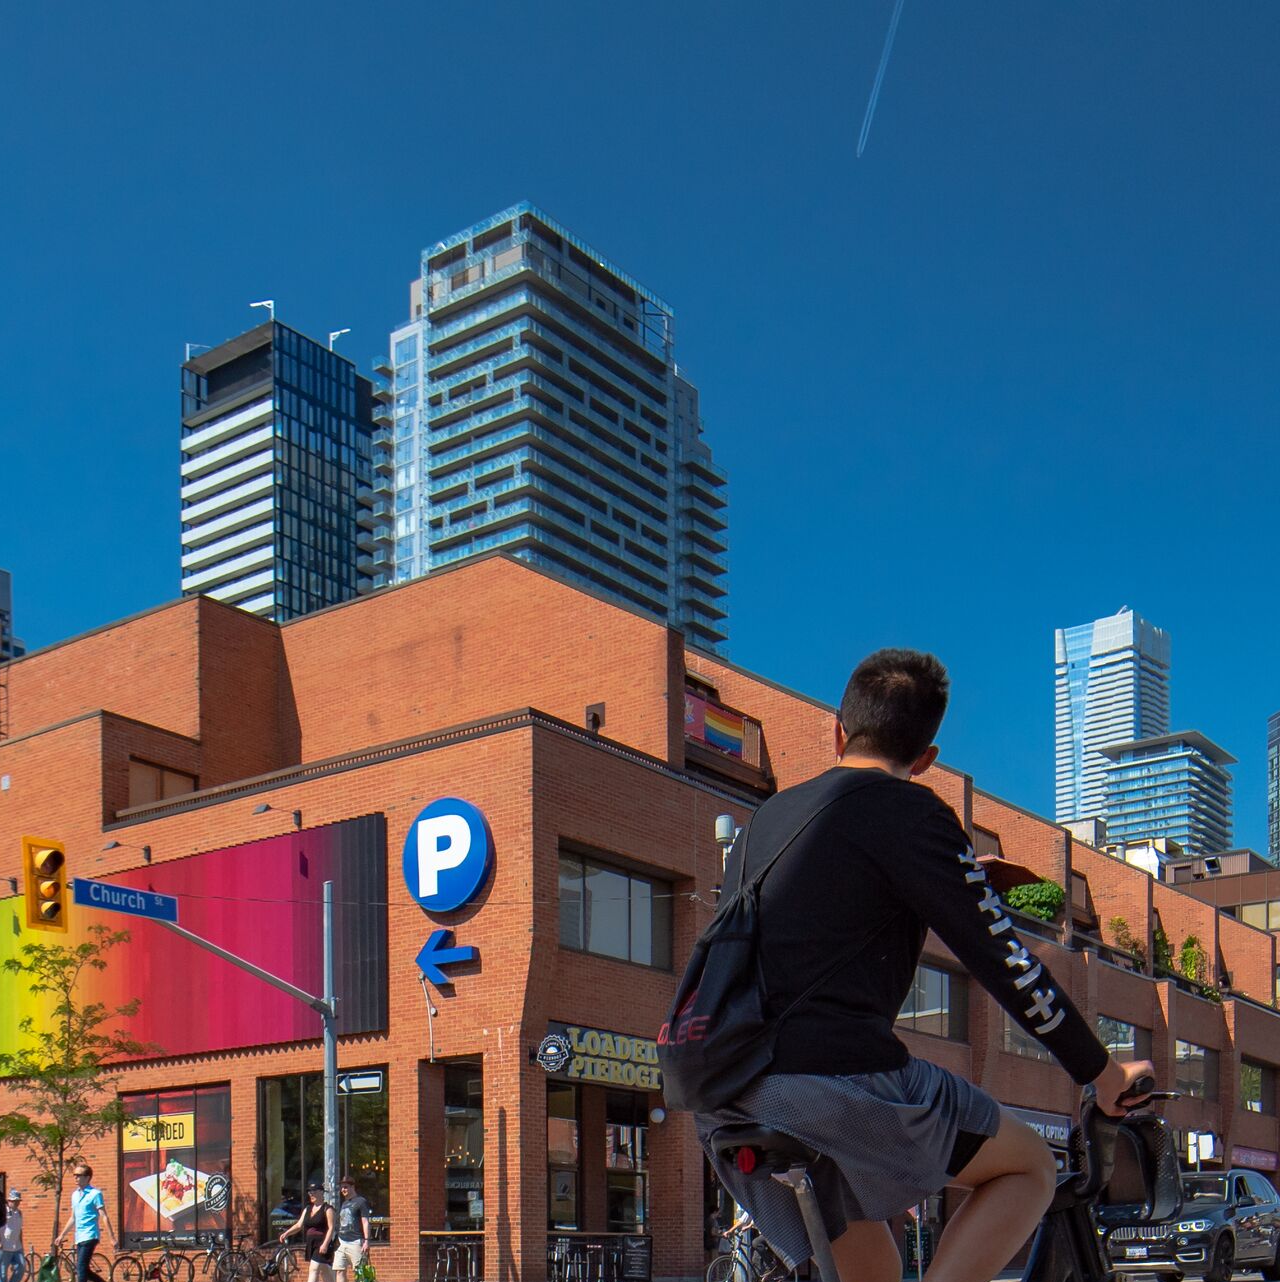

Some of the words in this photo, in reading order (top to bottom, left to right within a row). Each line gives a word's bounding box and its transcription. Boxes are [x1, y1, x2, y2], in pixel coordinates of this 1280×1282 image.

[417, 814, 472, 898] P
[89, 884, 146, 910] Church
[567, 1027, 659, 1065] LOADED
[568, 1056, 661, 1090] PIEROGI
